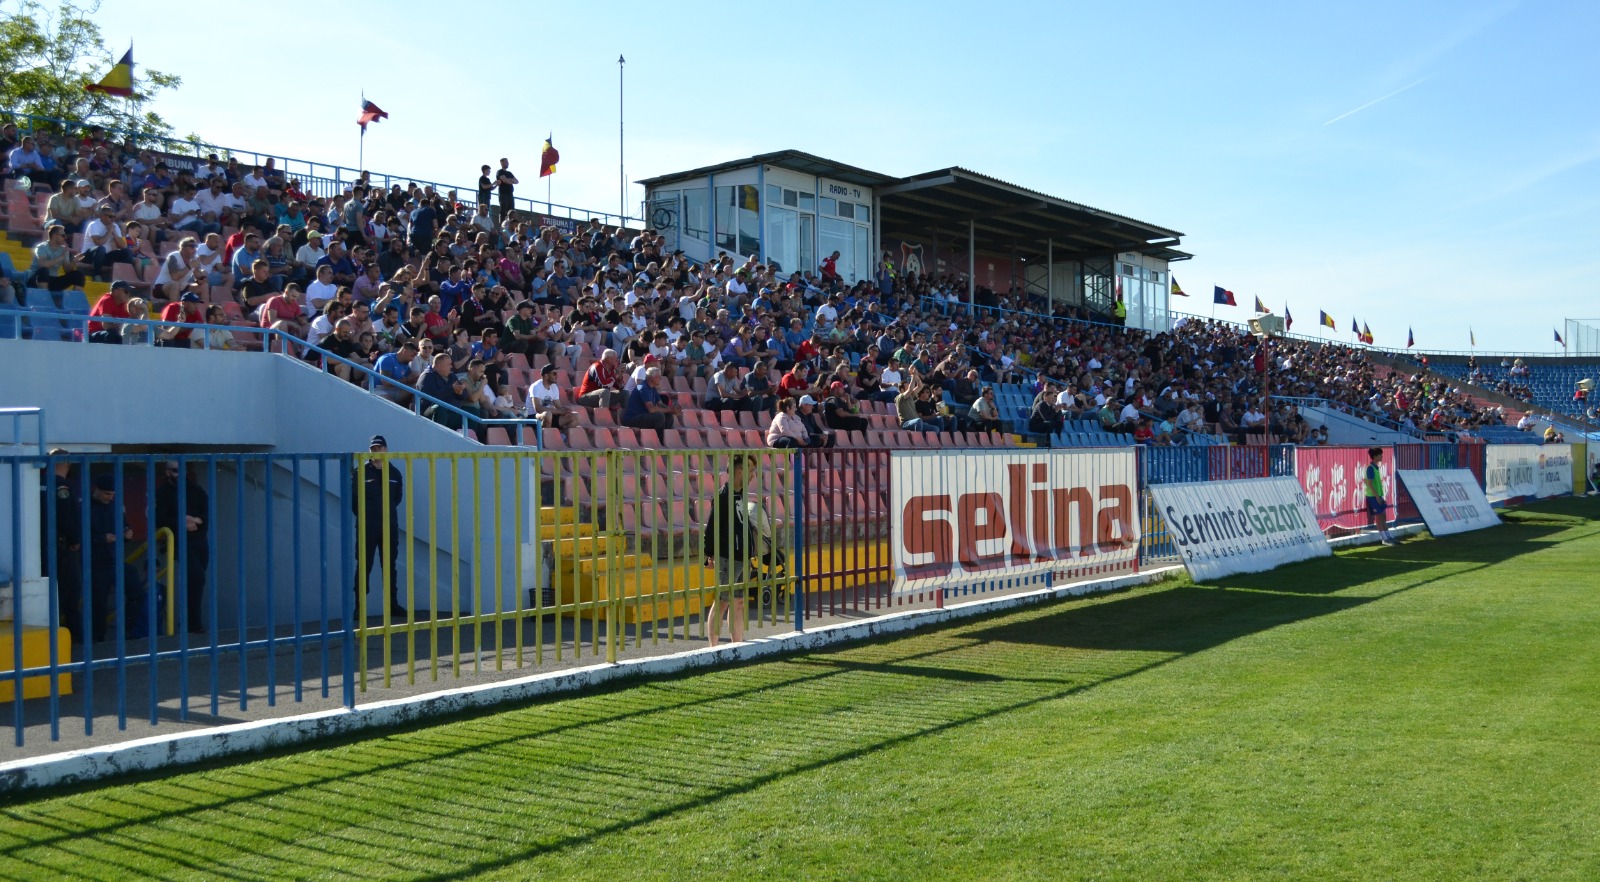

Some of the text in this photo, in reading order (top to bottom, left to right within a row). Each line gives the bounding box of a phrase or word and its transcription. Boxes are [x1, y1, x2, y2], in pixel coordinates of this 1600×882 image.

[830, 184, 848, 196] RADIO
[853, 189, 861, 199] TV
[543, 217, 568, 229] TRIBUNA
[1426, 476, 1470, 503] selina
[902, 463, 1134, 581] selina
